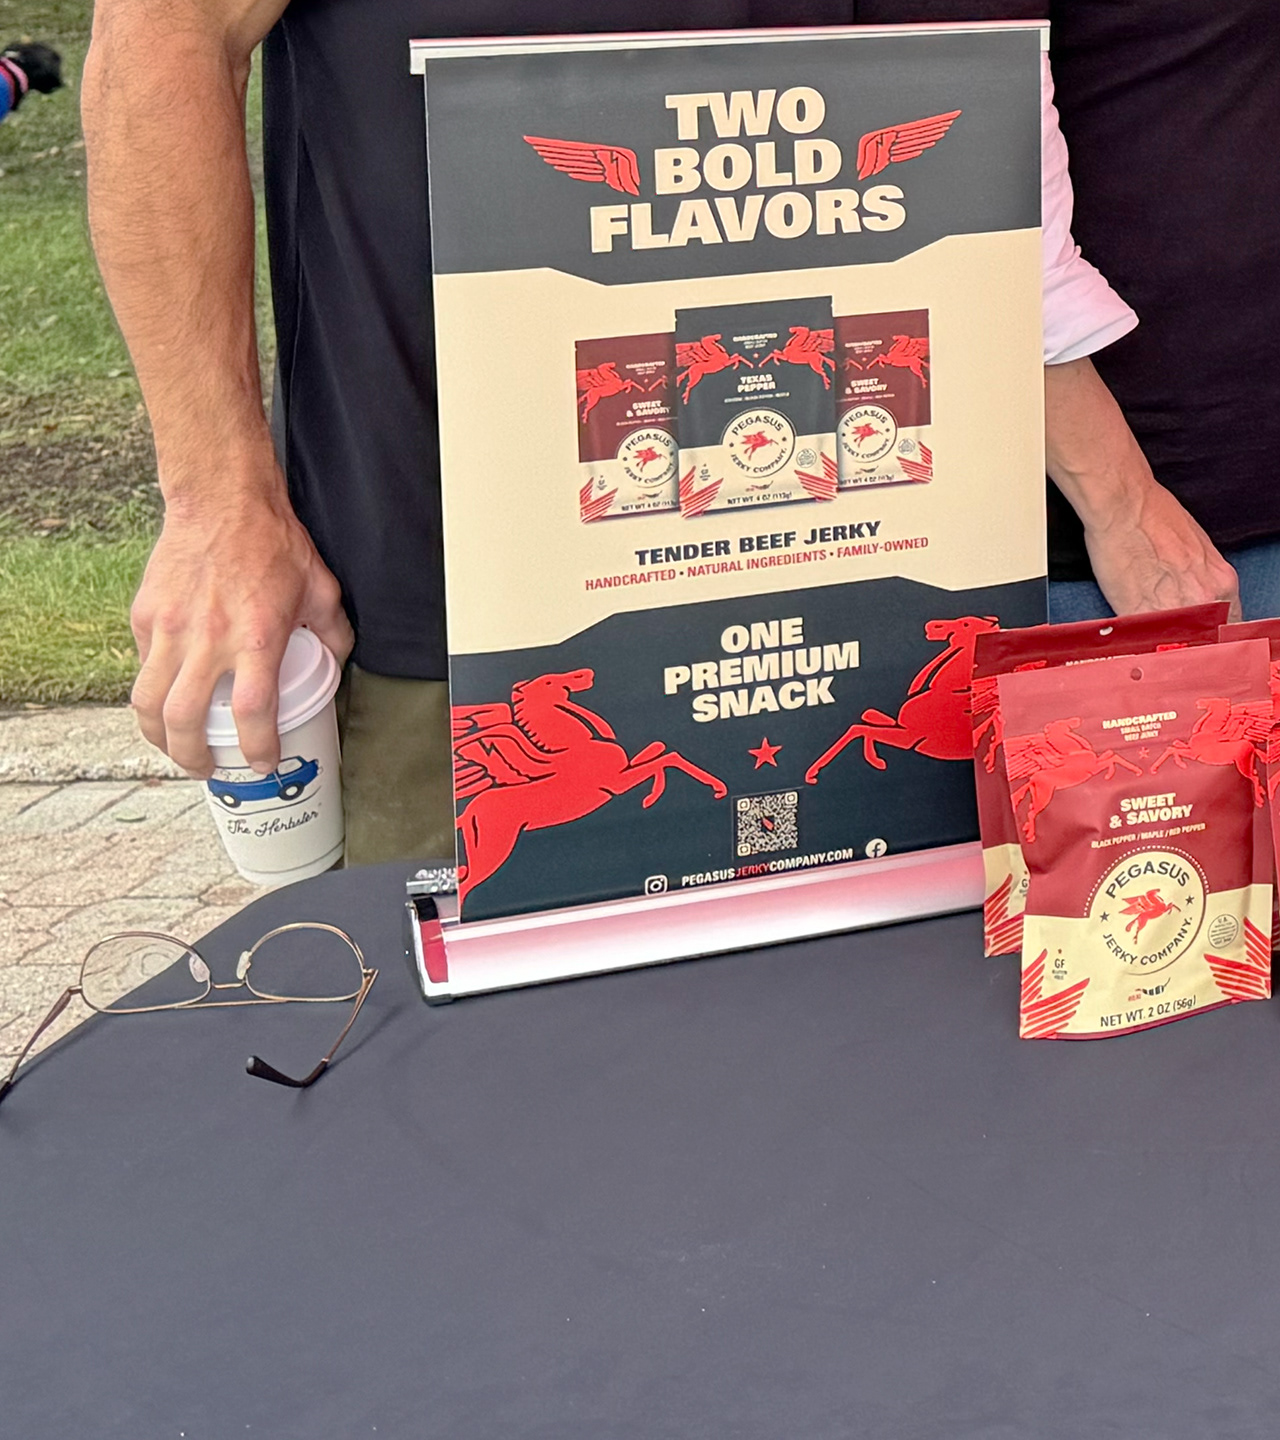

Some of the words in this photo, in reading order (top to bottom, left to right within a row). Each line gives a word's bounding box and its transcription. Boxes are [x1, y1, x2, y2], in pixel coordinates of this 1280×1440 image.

[666, 87, 826, 140] TWO
[655, 139, 842, 194] BOLD
[590, 185, 906, 253] FLAVORS
[732, 414, 784, 436] PEGASUS
[845, 410, 888, 427] PEGASUS
[626, 433, 672, 451] PEGASUS
[635, 540, 730, 566] TENDER
[739, 531, 796, 553] BEEF
[804, 521, 881, 545] JERKY
[586, 569, 676, 590] HANDCRAFTED
[688, 560, 744, 578] NATURAL
[747, 549, 826, 569] INGREDIENTS
[837, 537, 928, 558] FAMILY-OWNED
[721, 617, 804, 653] ONE
[664, 641, 859, 695] PREMIUM
[692, 676, 835, 723] SNACK
[1102, 712, 1176, 729] HANDCRAFTED
[1109, 816, 1122, 829] &
[1126, 804, 1193, 826] SAVORY
[1120, 792, 1176, 812] SWEET
[228, 818, 251, 834] The
[1091, 839, 1111, 849] BLACK
[1113, 834, 1136, 846] PEPPER
[1169, 826, 1181, 836] RED
[1183, 823, 1206, 834] PEPPER
[682, 848, 853, 888] PEGASUSJERKYCOMPANY.COM
[1106, 860, 1190, 899] PEGASUS
[1054, 959, 1065, 969] GF
[1103, 933, 1137, 965] JERKY
[1100, 1014, 1122, 1027] NET
[1149, 1006, 1155, 1018] 2
[1157, 1003, 1170, 1016] OZ
[1173, 995, 1196, 1012] (56g)
